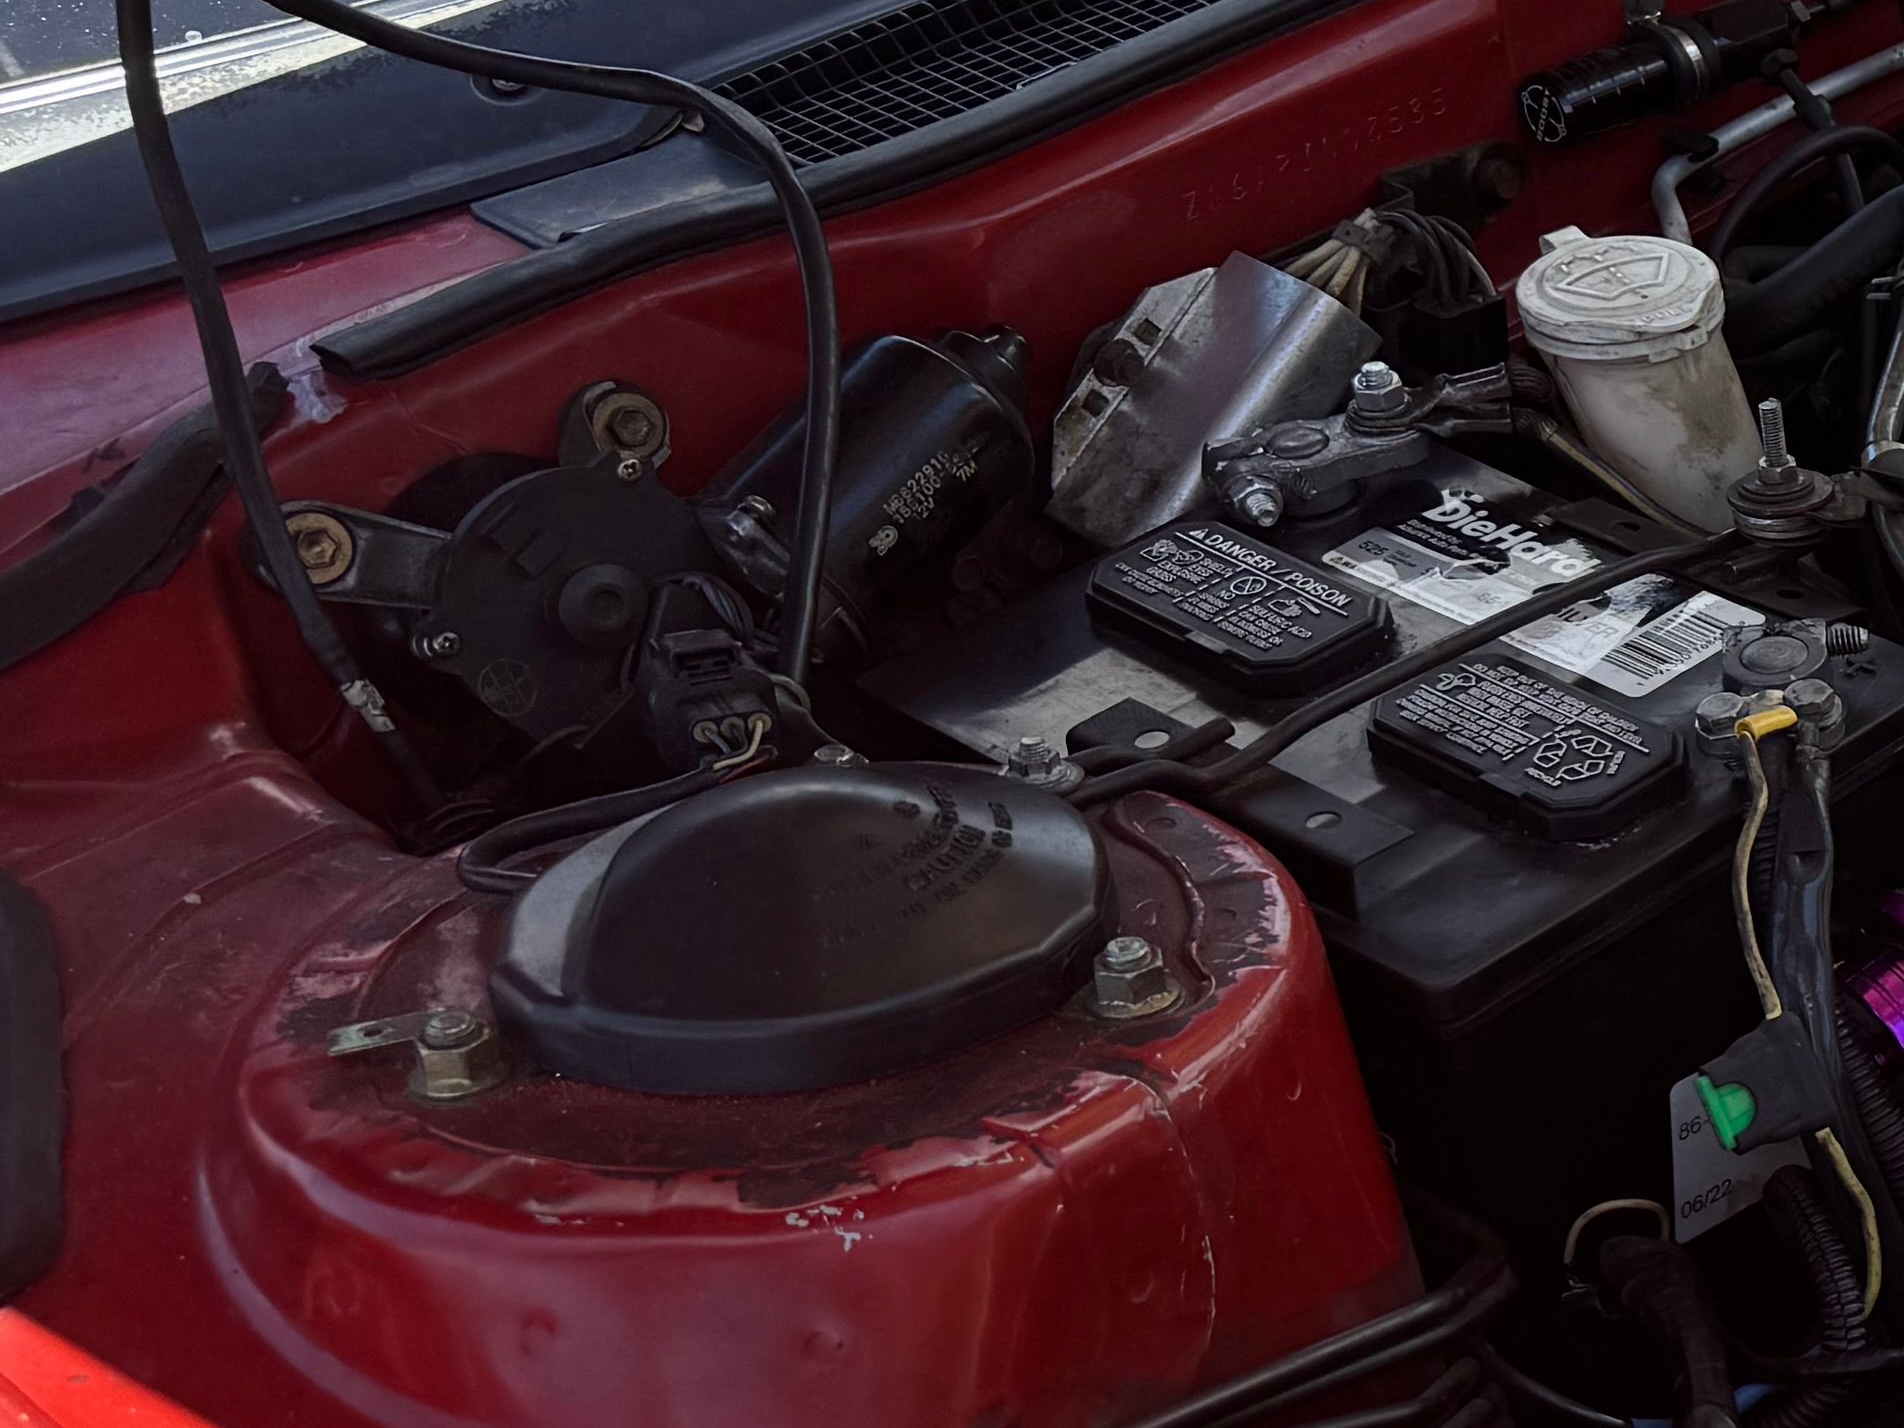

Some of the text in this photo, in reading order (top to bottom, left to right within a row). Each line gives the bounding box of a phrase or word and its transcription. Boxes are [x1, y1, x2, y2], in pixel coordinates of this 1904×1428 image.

[1358, 540, 1385, 556] 525
[1421, 500, 1602, 576] DieHard
[1204, 534, 1277, 571] DANGER
[1285, 572, 1352, 607] POISON
[1681, 1177, 1734, 1220] 06/22
